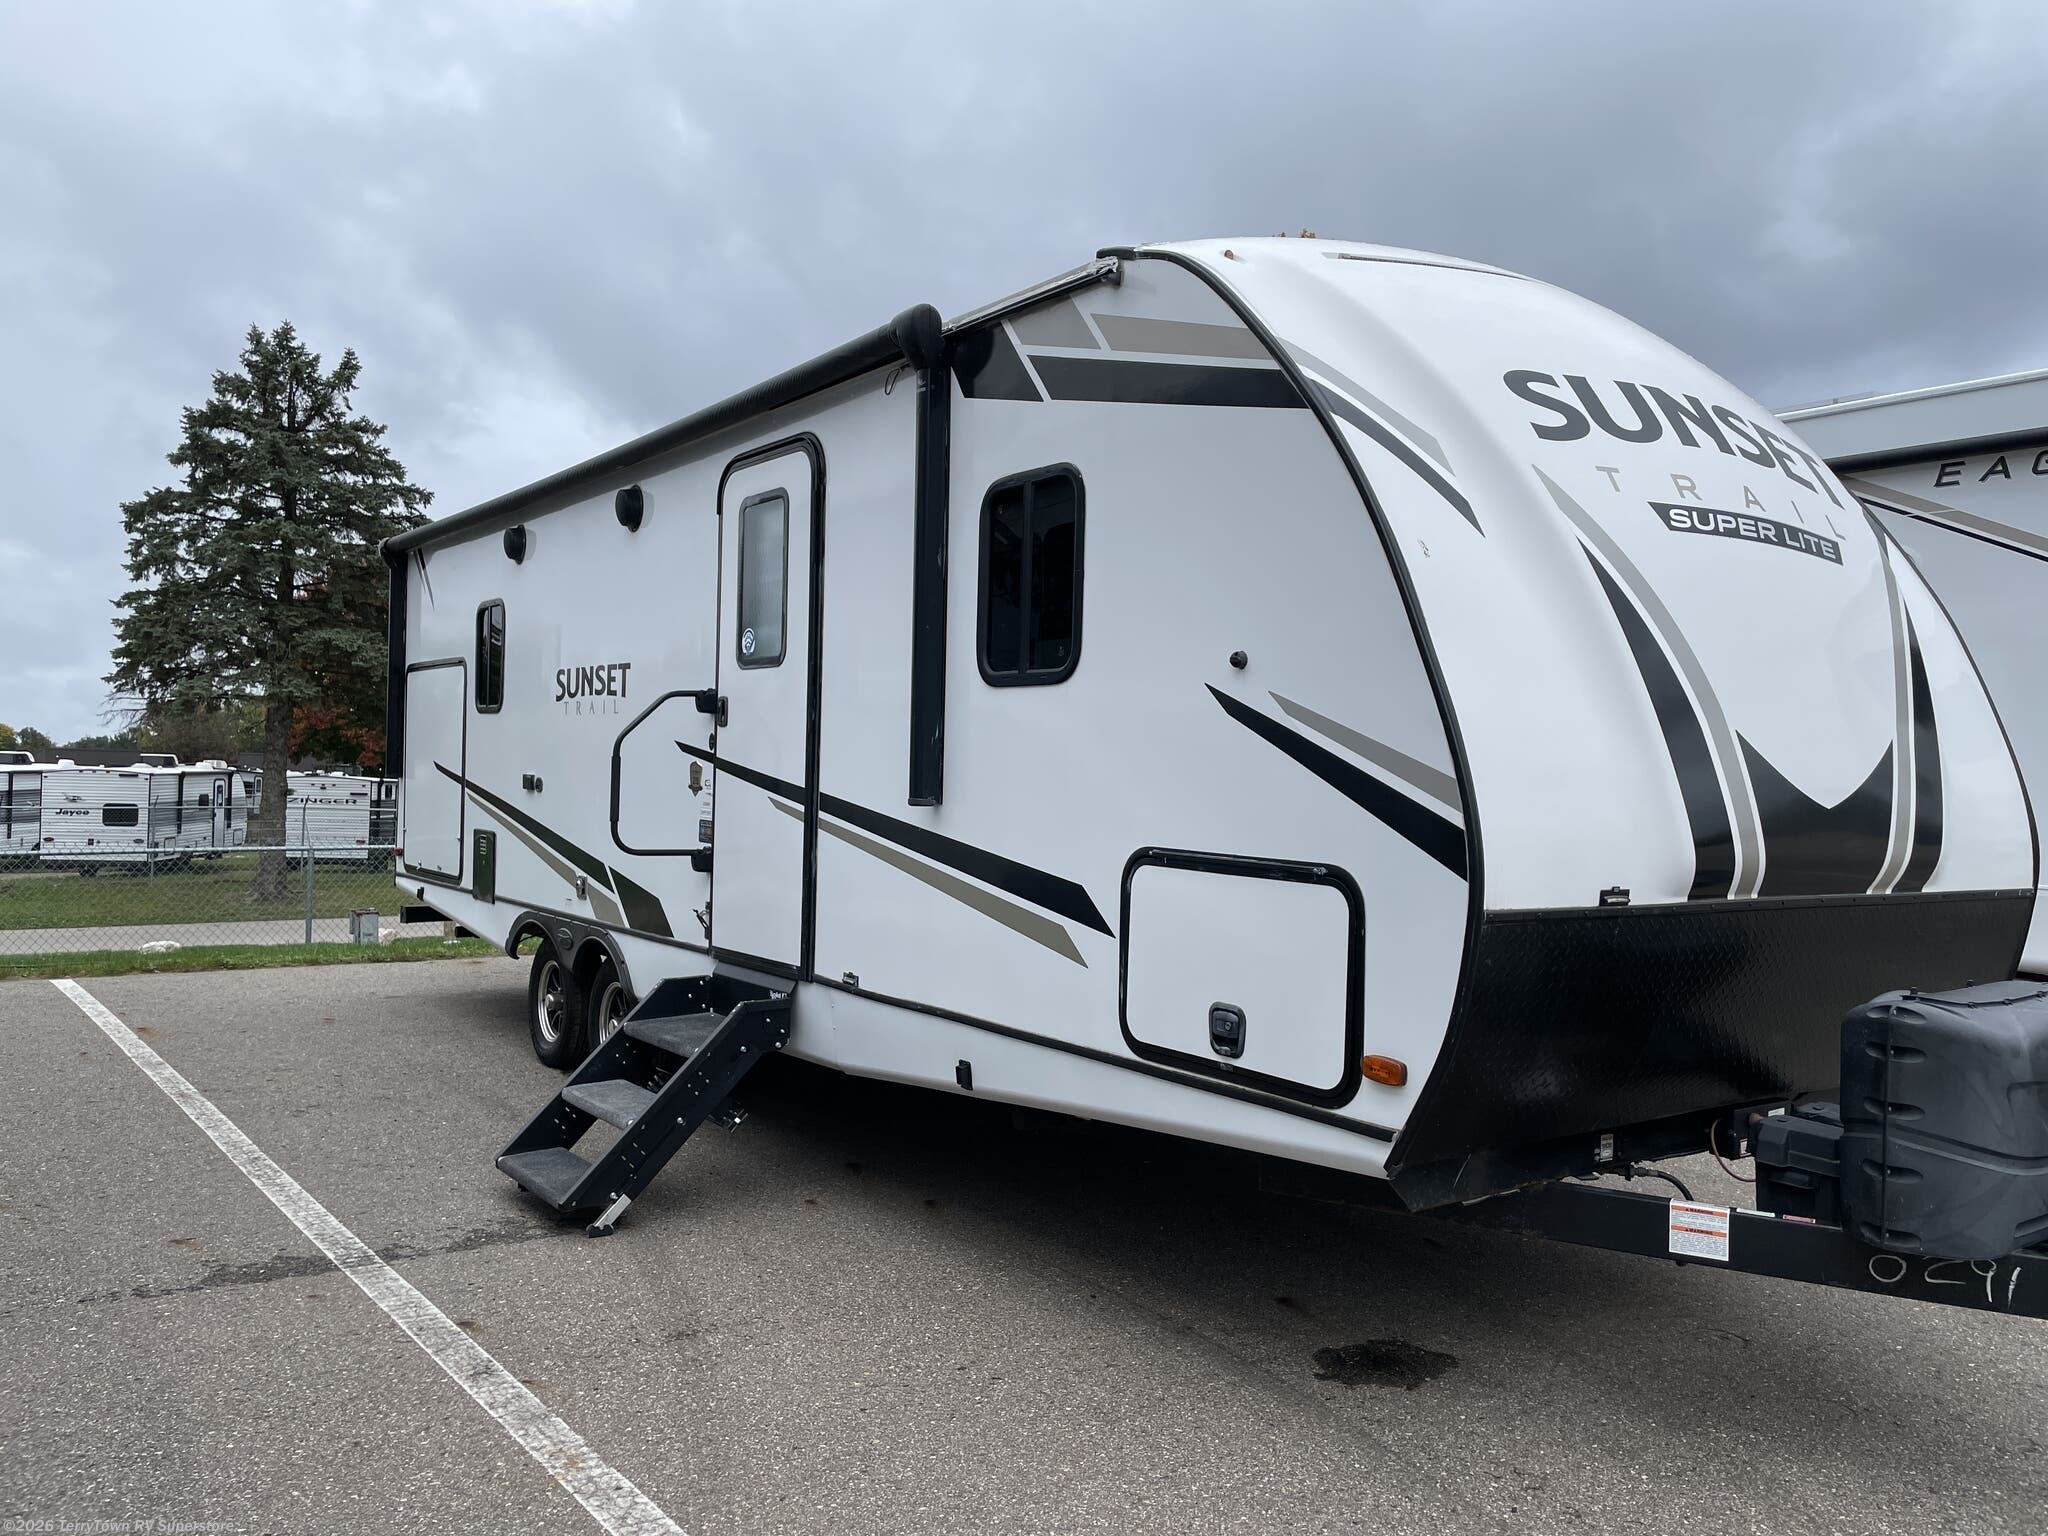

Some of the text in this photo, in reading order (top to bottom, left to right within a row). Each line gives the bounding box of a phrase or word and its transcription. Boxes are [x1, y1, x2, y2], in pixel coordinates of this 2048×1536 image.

[1503, 369, 1846, 511] SUNSET
[1595, 465, 1847, 541] TRAIL
[1668, 507, 1837, 560] SUPER LITE
[555, 662, 632, 703] SUNSET
[563, 698, 620, 716] TRAIL
[55, 808, 90, 817] Jayco
